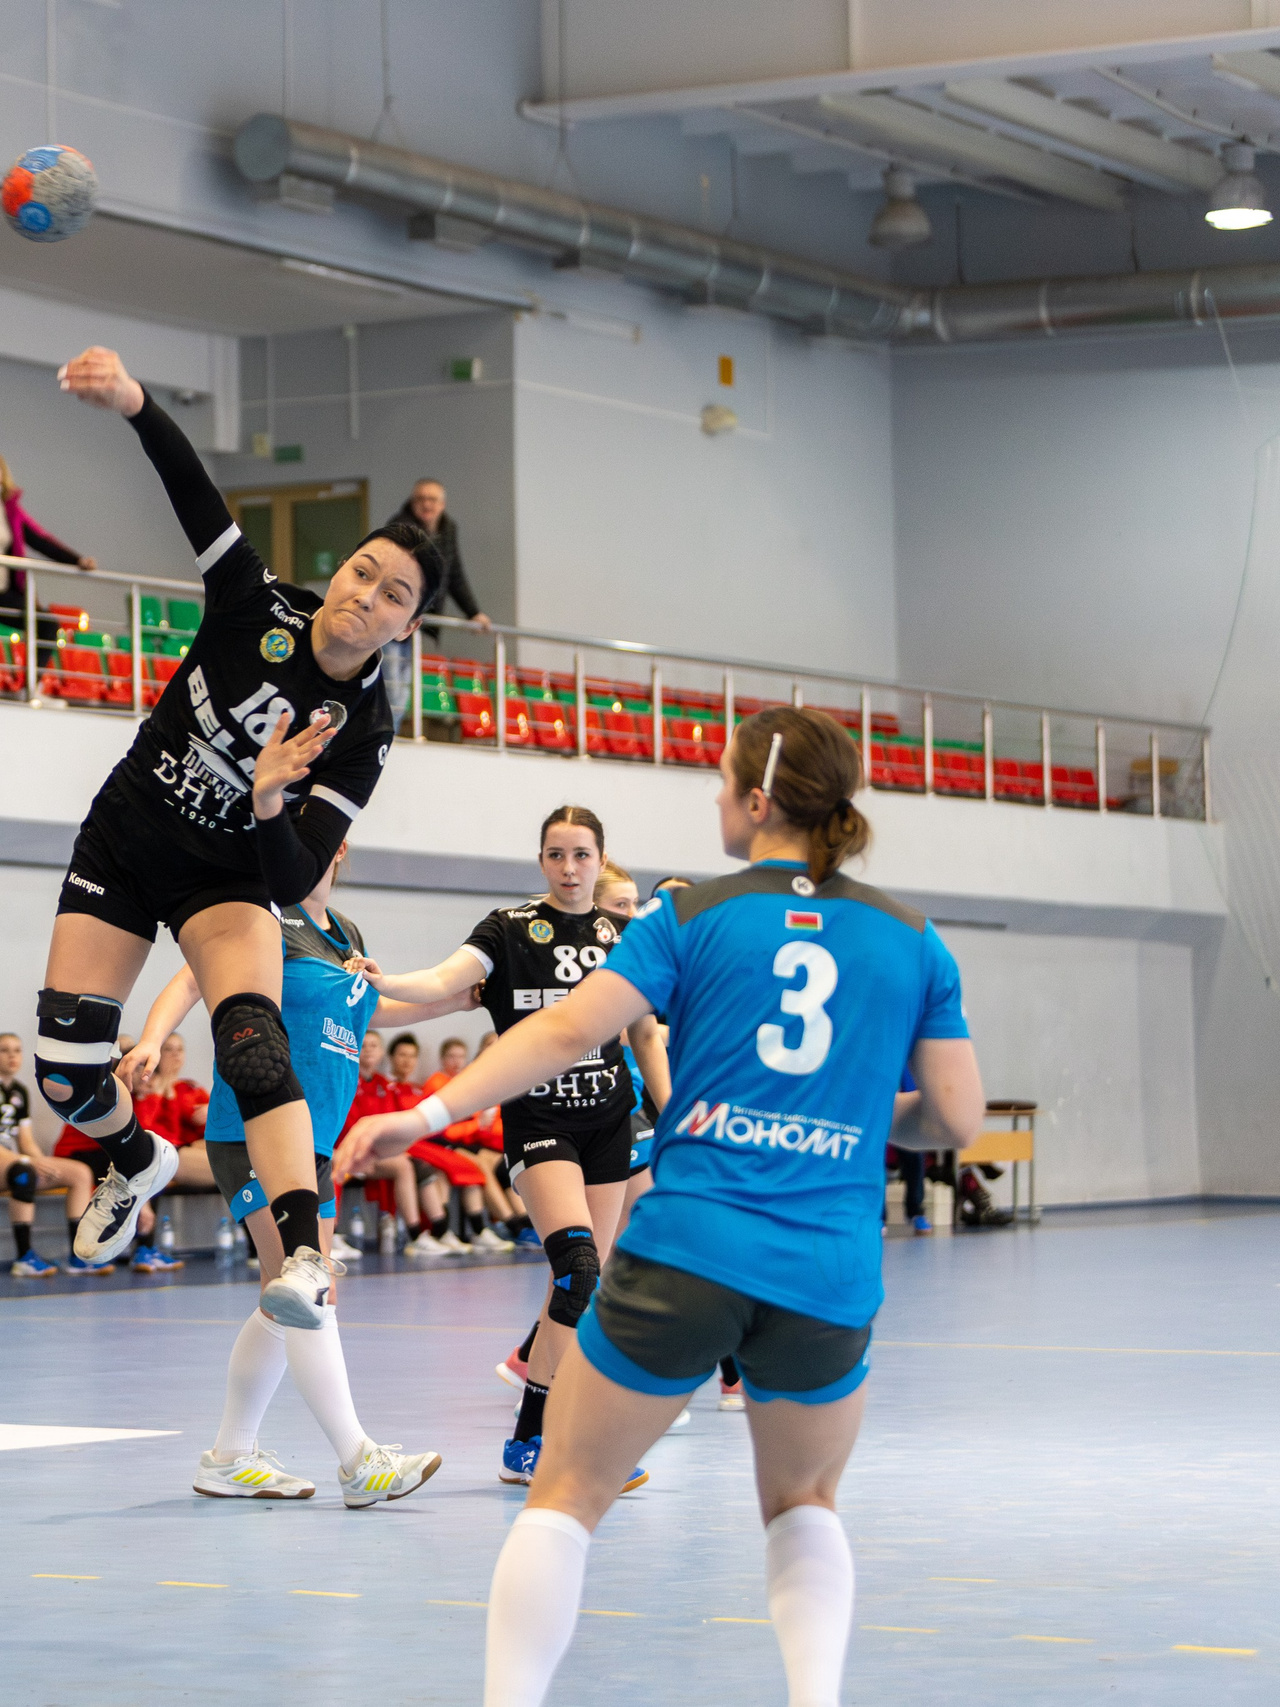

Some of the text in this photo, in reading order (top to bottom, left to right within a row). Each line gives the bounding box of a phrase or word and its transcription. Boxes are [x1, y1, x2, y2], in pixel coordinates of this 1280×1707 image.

[270, 602, 305, 630] Kempa
[228, 681, 296, 748] 18
[180, 806, 217, 829] 1920
[68, 871, 105, 896] Kempa
[507, 909, 538, 919] Kempa
[553, 945, 608, 983] 89
[756, 940, 839, 1076] 3
[566, 1098, 596, 1108] 1920
[523, 1138, 557, 1152] Kempa
